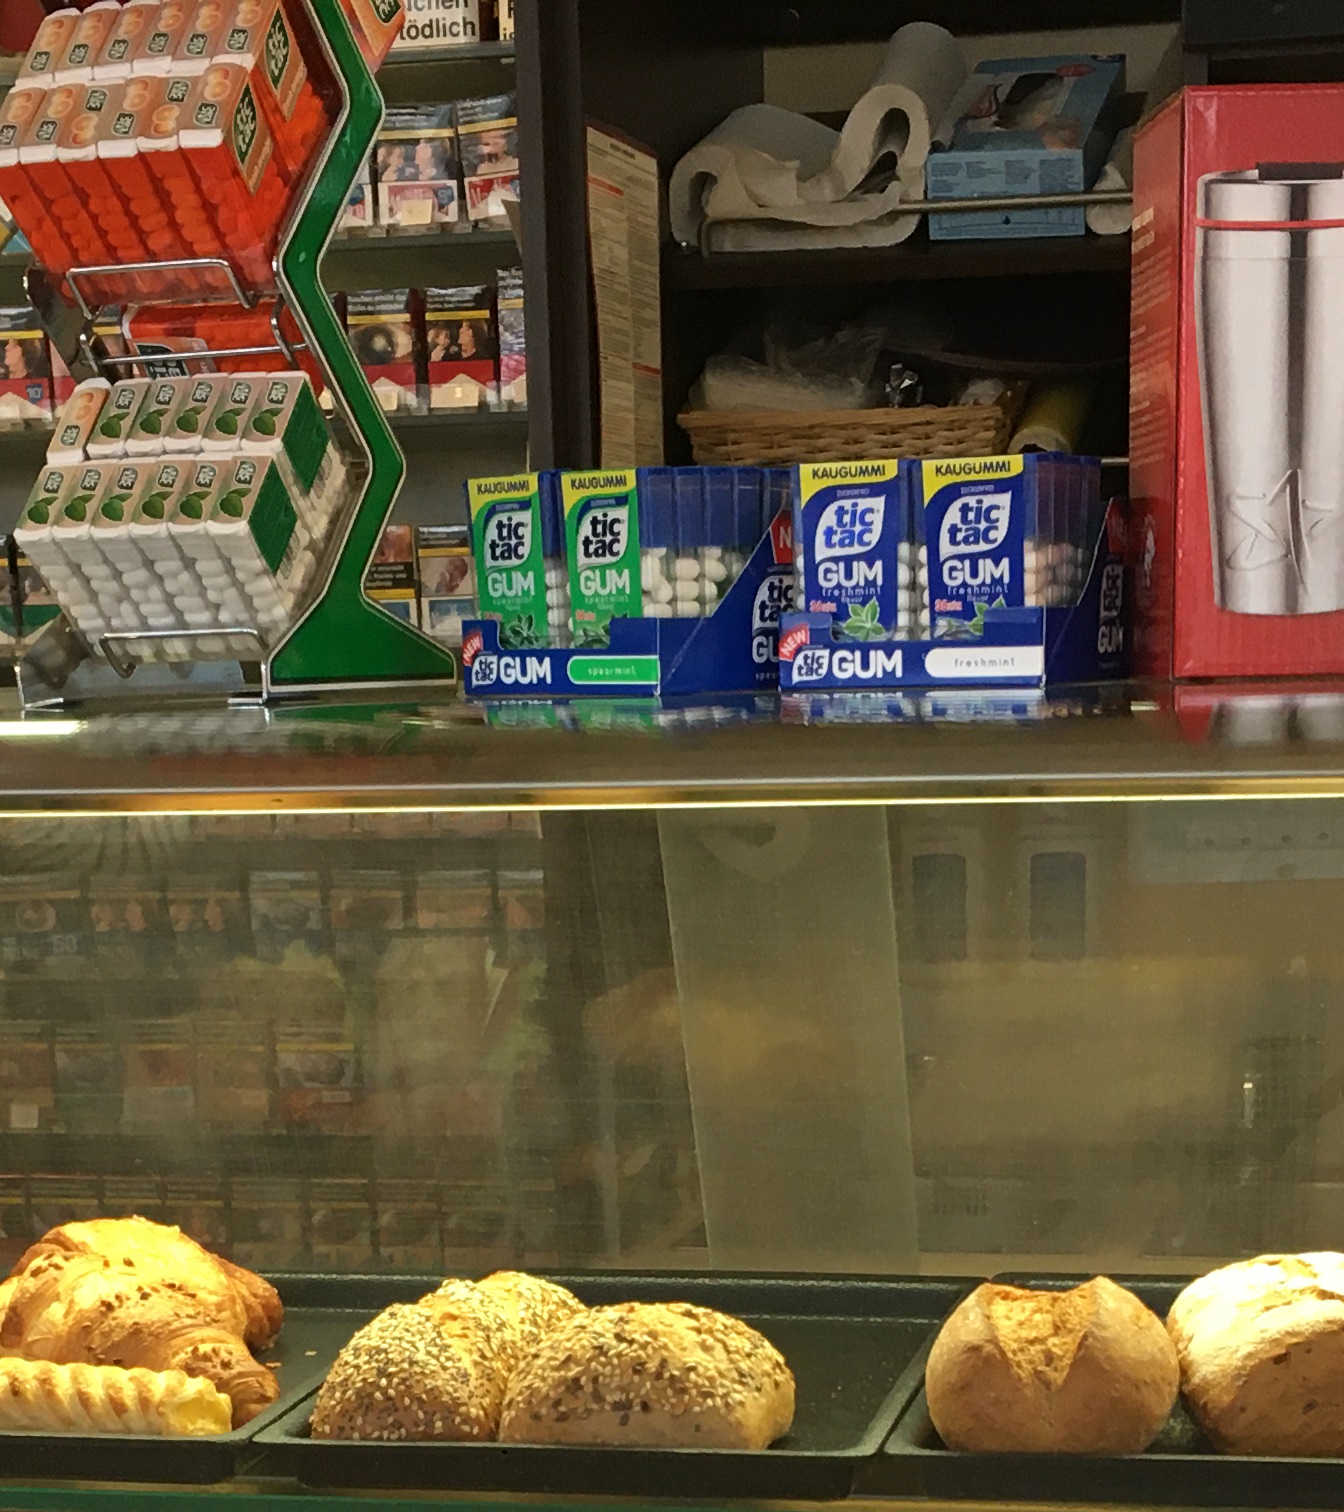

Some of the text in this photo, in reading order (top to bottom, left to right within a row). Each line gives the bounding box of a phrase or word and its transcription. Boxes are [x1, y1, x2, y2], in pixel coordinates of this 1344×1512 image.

[812, 465, 885, 480] KAUGUMMI
[935, 461, 1011, 477] KAUGUMMI
[477, 479, 529, 495] KAUGUMMI
[571, 475, 627, 490] KAUGUMMI
[834, 502, 875, 528] tic
[959, 499, 1000, 524] tic
[496, 516, 525, 541] tic
[590, 513, 621, 539] tic
[823, 524, 872, 548] tac
[948, 521, 998, 546] tac
[489, 536, 524, 561] tac
[582, 535, 620, 558] tac
[488, 571, 535, 597] GUM
[580, 569, 630, 595] GUM
[818, 559, 882, 587] GUM
[943, 557, 1009, 586] GUM
[463, 636, 482, 660] NEW
[780, 627, 808, 657] NEW
[500, 656, 551, 684] GUM
[797, 663, 824, 678] tac
[804, 652, 824, 667] tic
[832, 650, 902, 678] GUM
[954, 656, 1015, 667] freshmint
